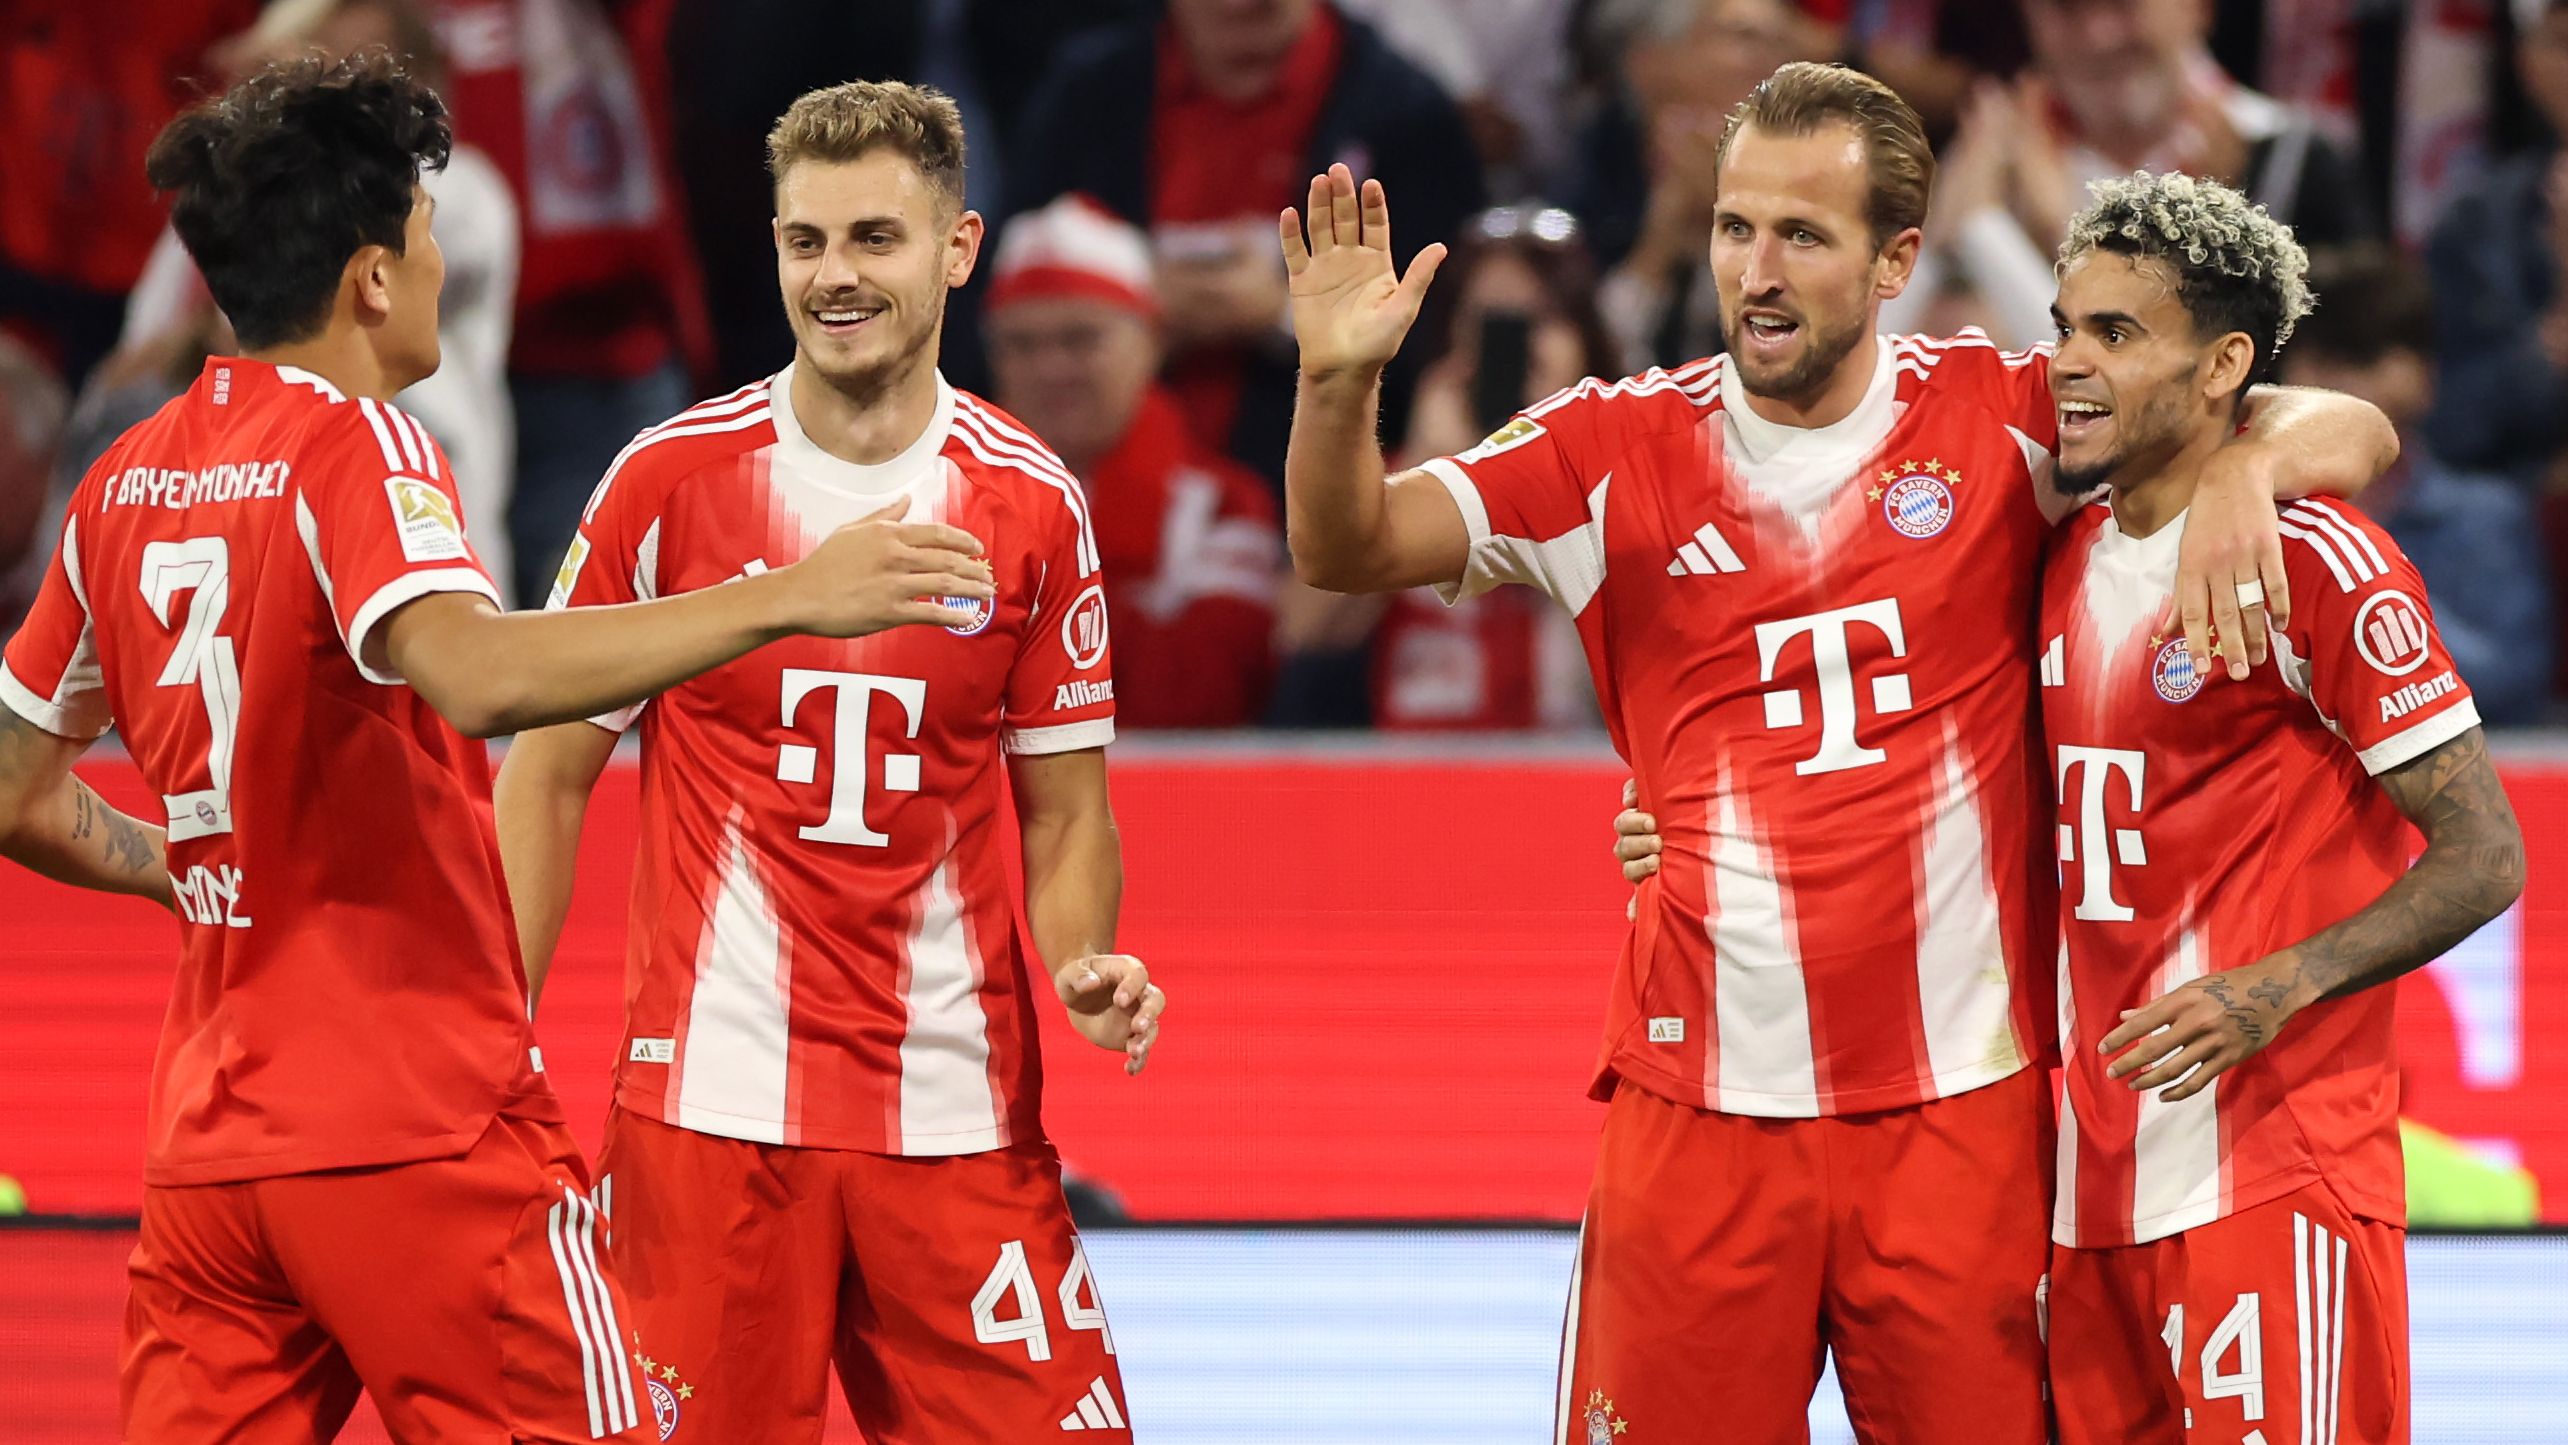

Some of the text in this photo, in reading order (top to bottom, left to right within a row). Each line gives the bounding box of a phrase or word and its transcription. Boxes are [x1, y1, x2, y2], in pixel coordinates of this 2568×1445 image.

[1888, 480, 1945, 507] FC BAYERN
[777, 668, 927, 847] T
[1754, 597, 1912, 776] T
[2378, 670, 2458, 723] Allianz
[2057, 744, 2147, 922] T
[970, 1233, 1116, 1362] 44
